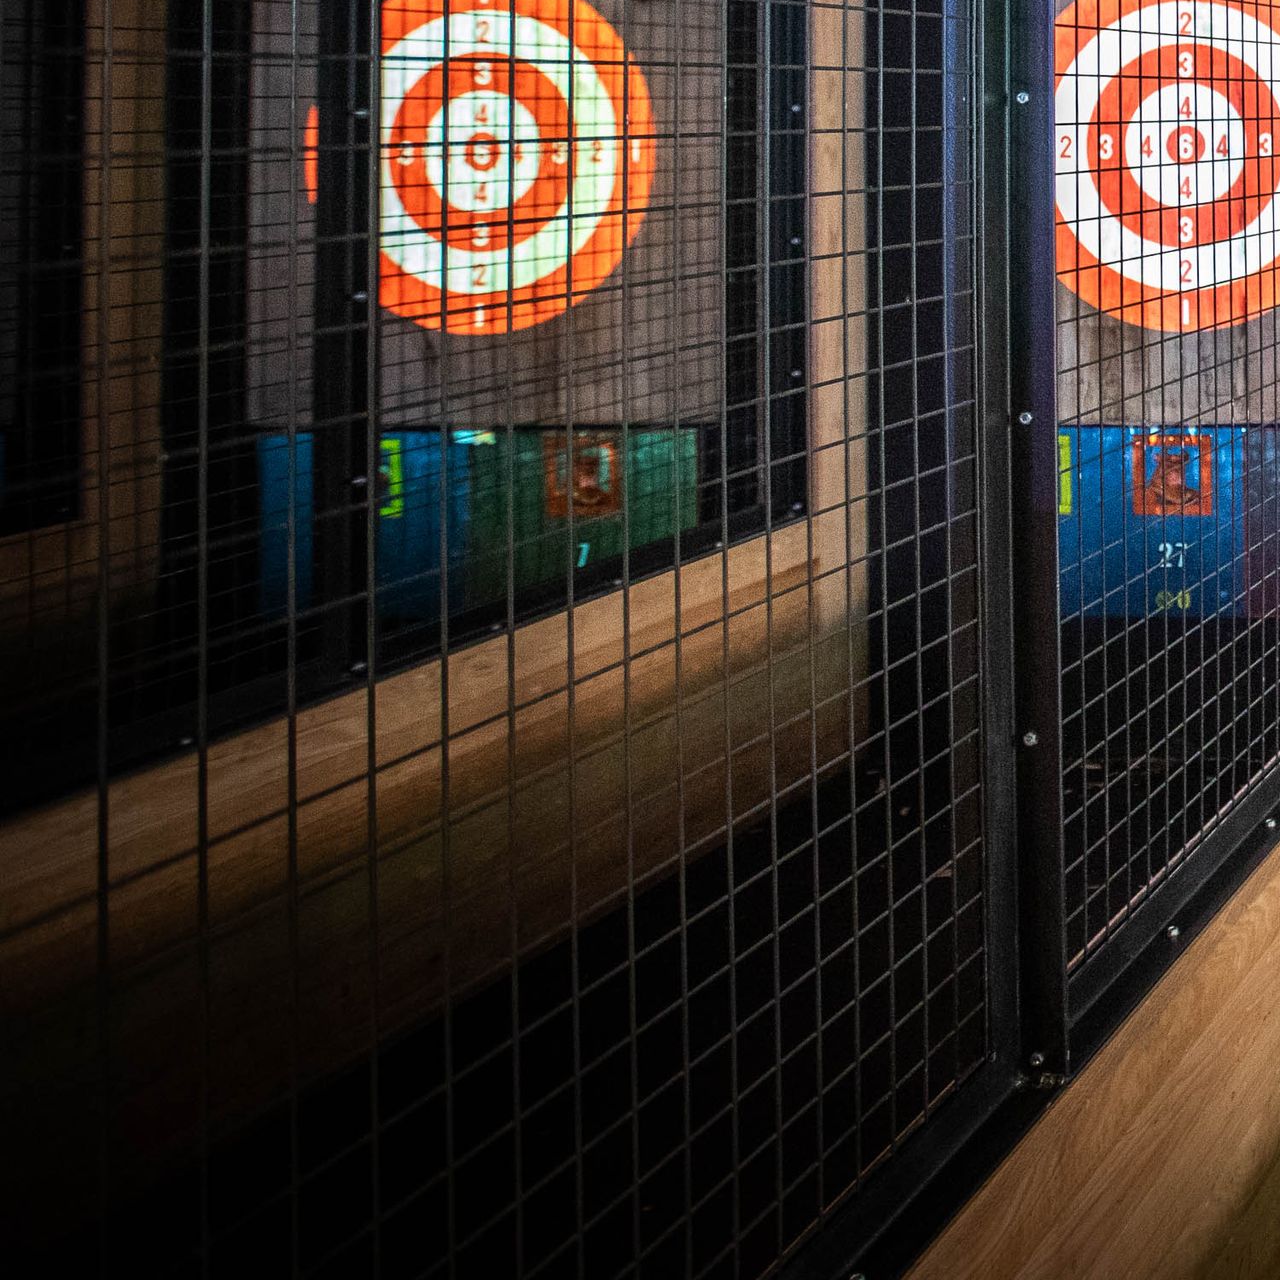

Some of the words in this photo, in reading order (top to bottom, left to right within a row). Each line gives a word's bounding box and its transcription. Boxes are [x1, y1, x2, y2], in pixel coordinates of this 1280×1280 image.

[477, 20, 489, 43] 2
[1180, 12, 1192, 35] 2
[1179, 51, 1194, 77] 3
[1180, 96, 1192, 119] 4
[1060, 136, 1072, 158] 2
[1098, 133, 1114, 160] 3
[1141, 136, 1153, 158] 4
[1179, 133, 1194, 159] 6
[1216, 134, 1229, 157] 4
[1258, 132, 1273, 158] 3
[1180, 177, 1192, 199] 4
[1179, 216, 1194, 243] 3
[472, 263, 487, 286] 2
[1180, 259, 1192, 283] 2
[1158, 542, 1187, 568] 27
